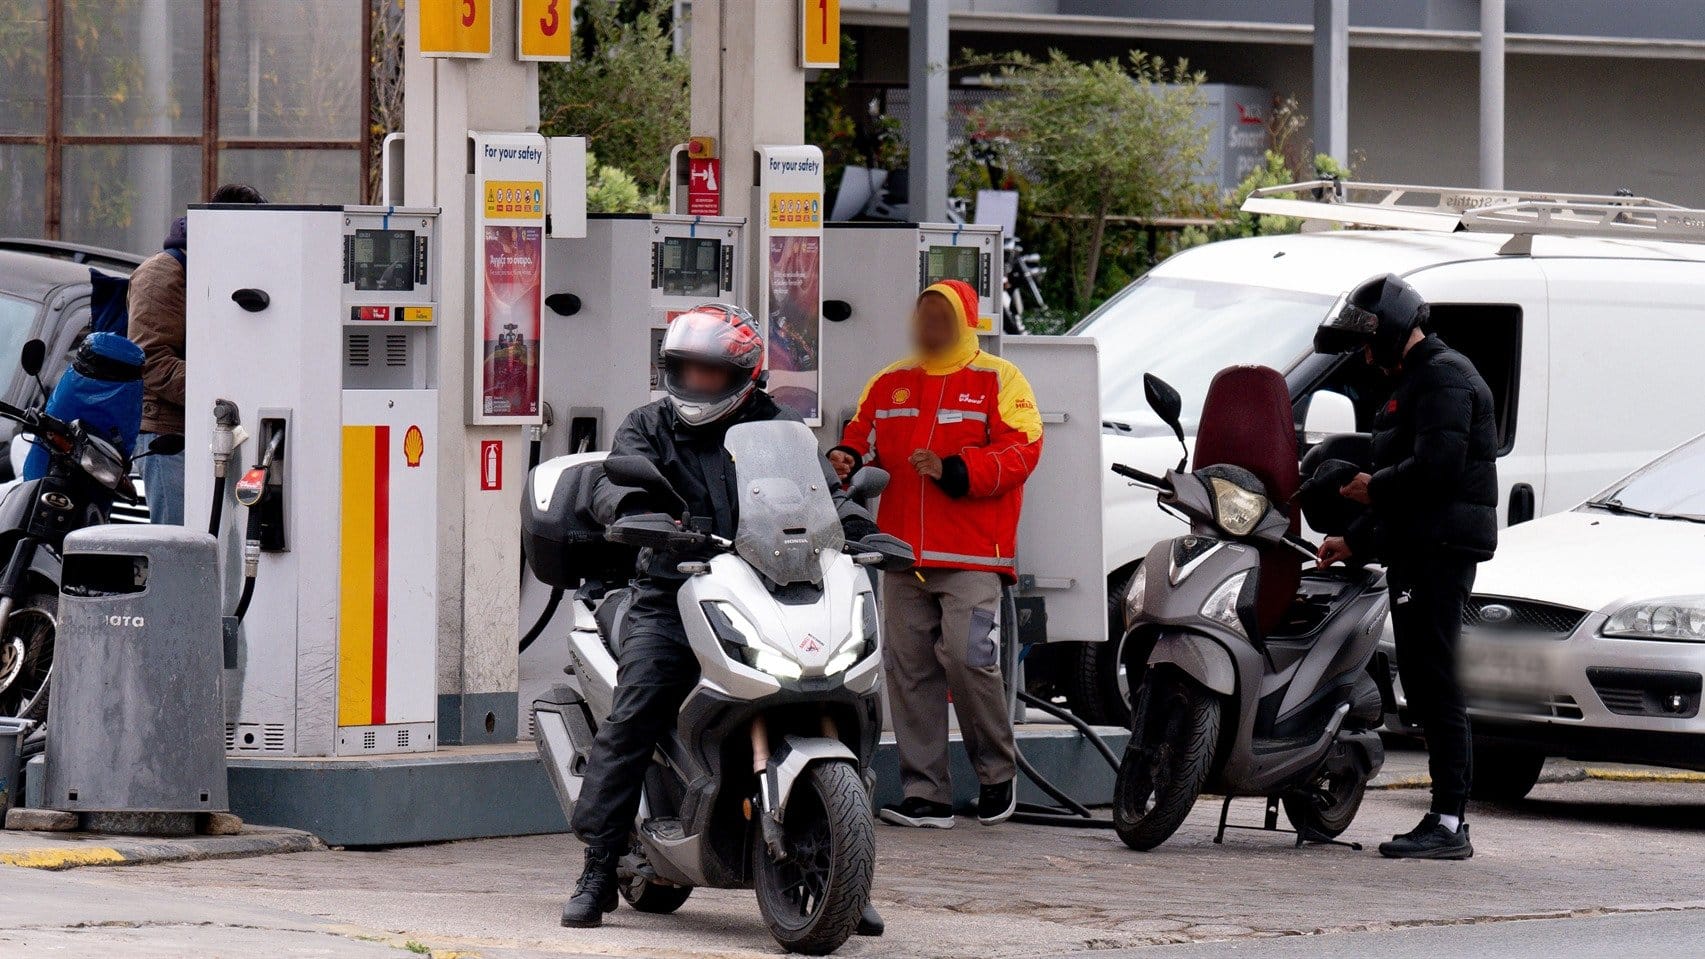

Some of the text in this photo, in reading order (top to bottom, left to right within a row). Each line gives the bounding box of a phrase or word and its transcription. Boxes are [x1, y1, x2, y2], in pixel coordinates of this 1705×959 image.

[540, 0, 559, 37] 3
[819, 0, 828, 45] 1
[485, 144, 542, 164] For your safety
[769, 157, 819, 175] For your safety
